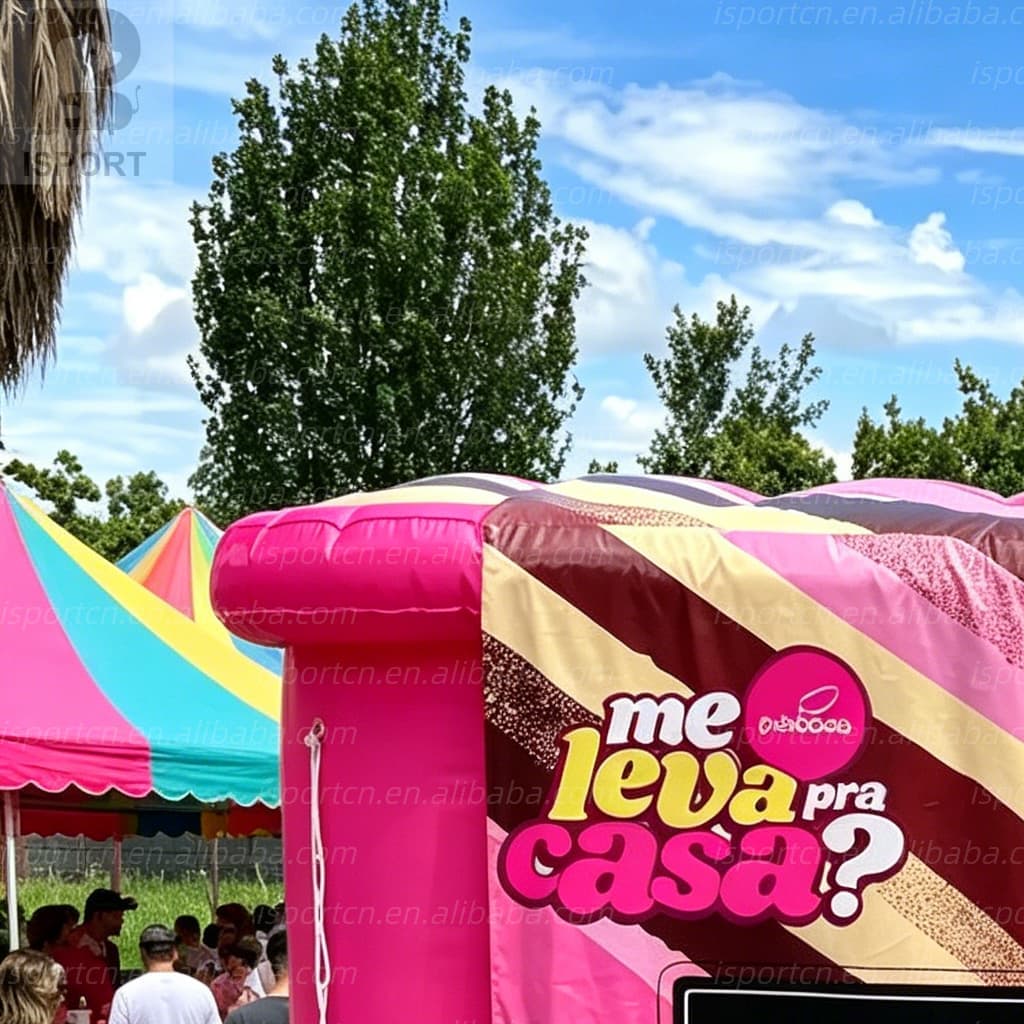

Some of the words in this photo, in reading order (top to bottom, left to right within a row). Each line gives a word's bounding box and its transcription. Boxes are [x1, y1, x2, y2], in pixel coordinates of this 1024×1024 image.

[606, 692, 741, 749] me
[548, 727, 798, 828] leva
[802, 781, 887, 821] pra
